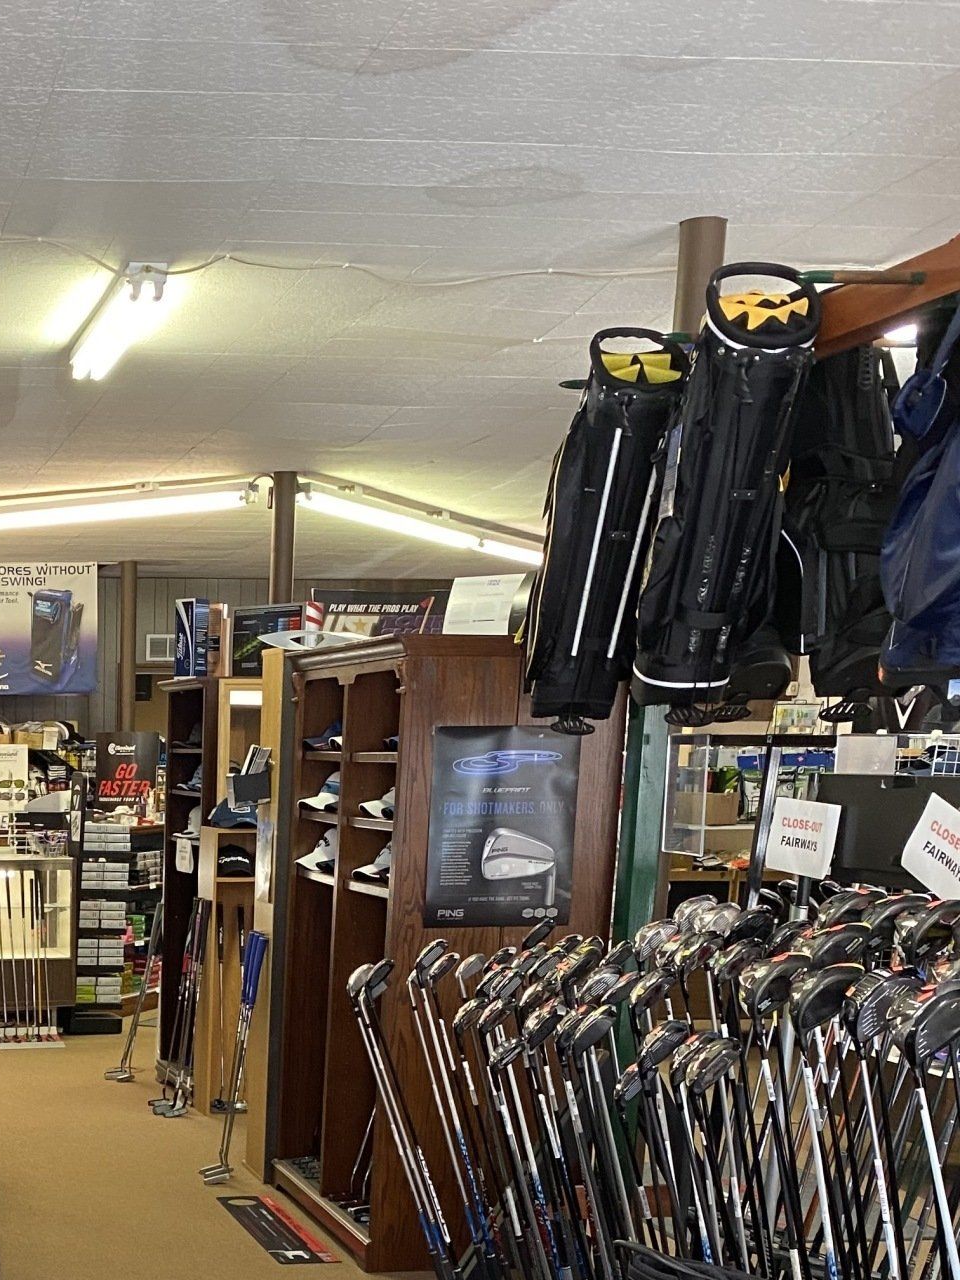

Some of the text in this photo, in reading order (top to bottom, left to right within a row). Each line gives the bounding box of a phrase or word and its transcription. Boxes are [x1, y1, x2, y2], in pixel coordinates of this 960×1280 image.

[36, 564, 91, 575] WITHOUT
[1, 576, 46, 587] SWING!
[329, 603, 419, 613] PLAY WHAT THE PROS PLAY
[115, 764, 138, 778] GO
[99, 780, 151, 796] FASTER
[444, 801, 464, 816] FOR
[541, 801, 565, 814] ONLY
[781, 816, 823, 834] CLOSE-OUT
[780, 835, 818, 852] FAIRWAYS
[437, 909, 464, 917] PING
